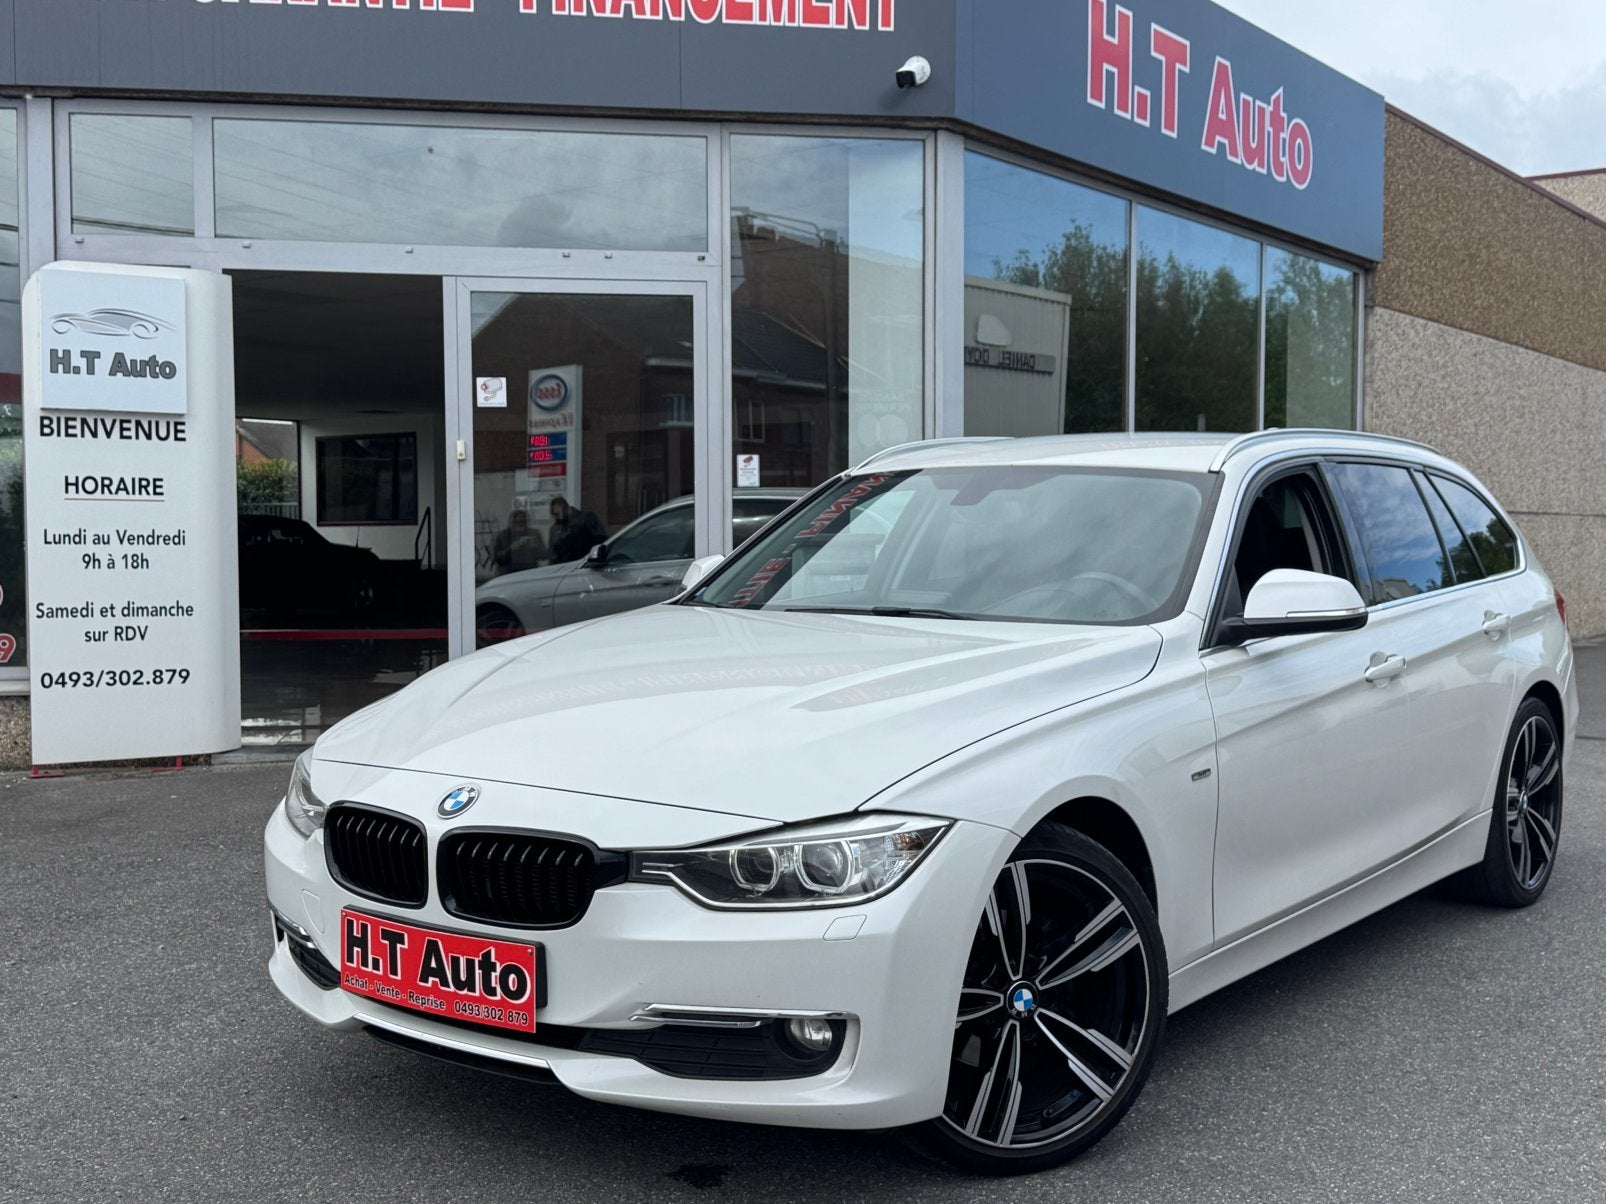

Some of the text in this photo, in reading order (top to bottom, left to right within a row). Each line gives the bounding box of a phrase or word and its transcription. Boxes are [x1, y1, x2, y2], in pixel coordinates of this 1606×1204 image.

[1087, 0, 1314, 190] H.T Auto
[50, 348, 177, 380] H.T Auto
[40, 416, 187, 442] BIENVENUE
[64, 476, 165, 496] HORAIRE
[43, 528, 186, 546] Lundi au Vendredi
[82, 553, 150, 570] 9h à 18h
[36, 600, 194, 619] Samedi et dimanche
[84, 625, 149, 643] sur RDV
[41, 668, 191, 689] 0493/302.879
[344, 917, 531, 1004] H.T Auto
[344, 973, 368, 991] Achat
[375, 983, 401, 999] Vente
[408, 990, 446, 1010] Reprise
[507, 1010, 529, 1026] 879
